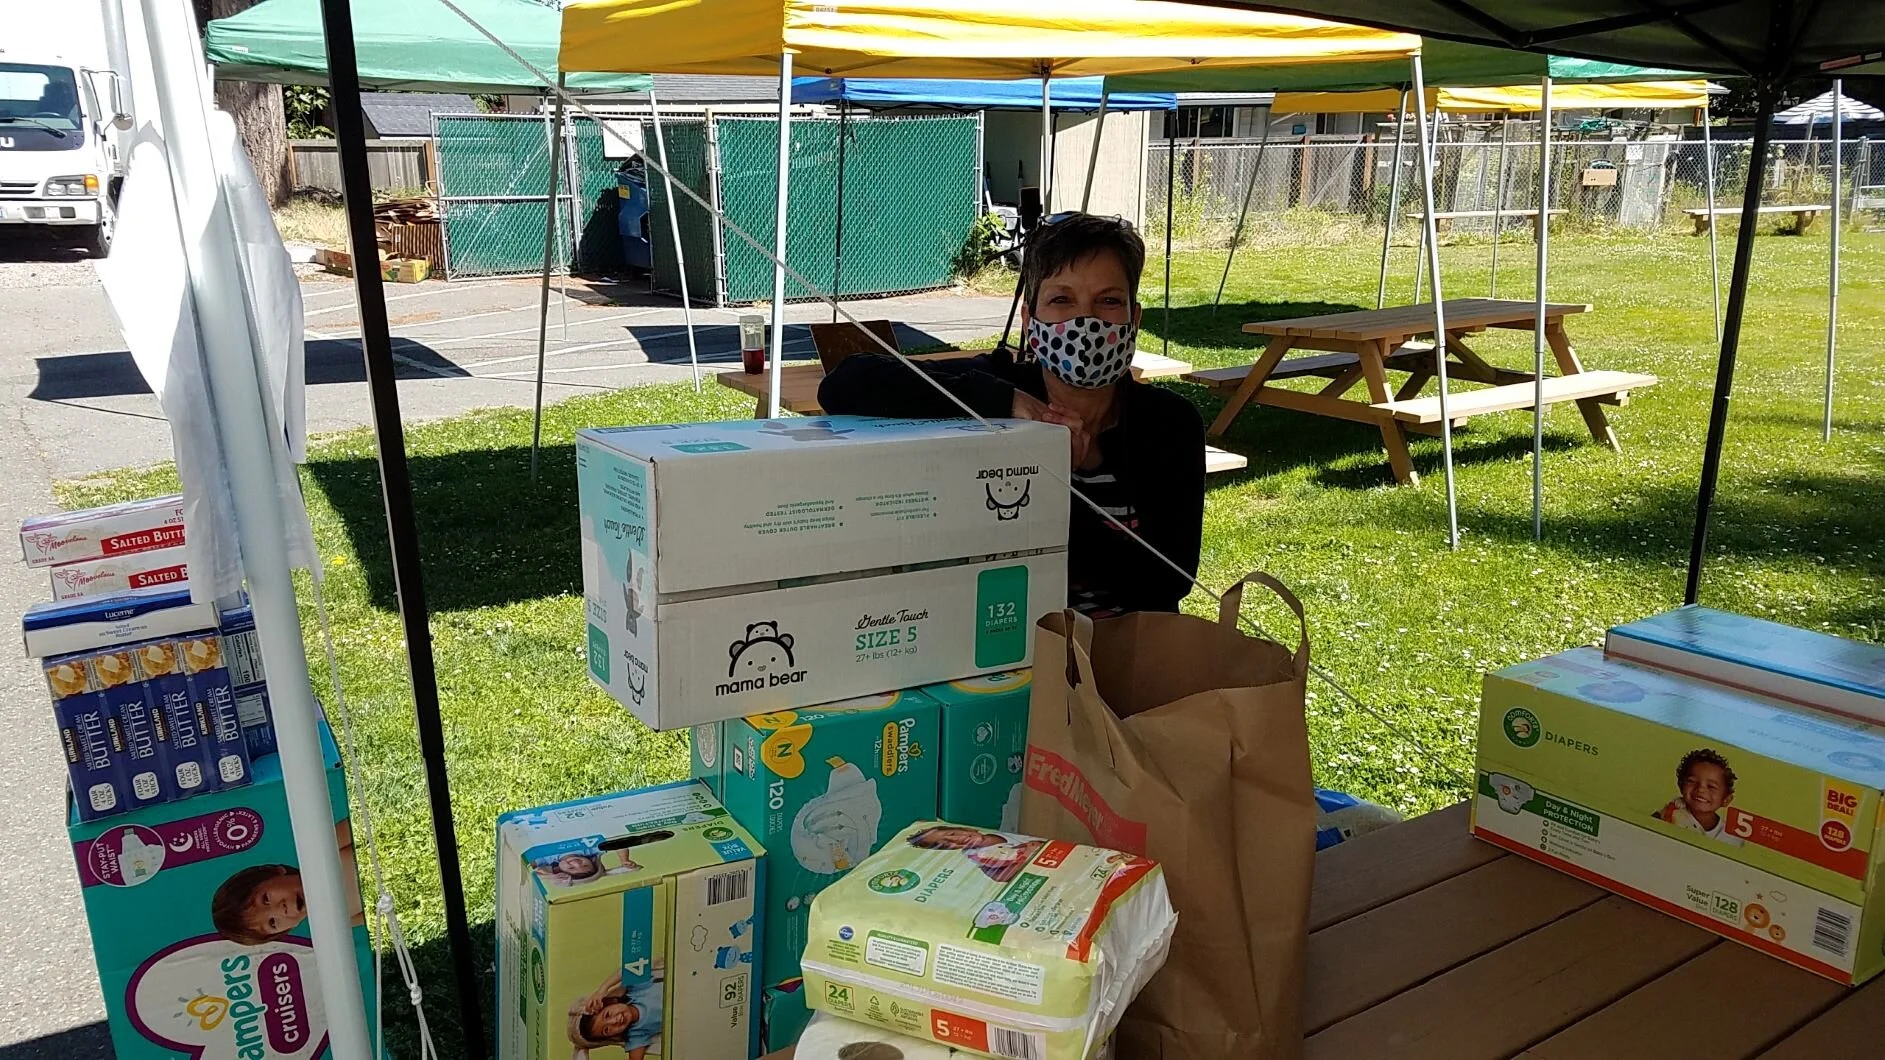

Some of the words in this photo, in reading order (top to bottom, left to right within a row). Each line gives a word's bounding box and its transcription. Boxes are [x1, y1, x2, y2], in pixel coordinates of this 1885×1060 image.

[976, 468, 1002, 480] bear
[1006, 465, 1039, 478] mama
[110, 536, 150, 550] SALTED
[140, 572, 178, 586] SALTED
[105, 609, 136, 620] Lucerne
[855, 614, 896, 630] Gentle
[896, 609, 928, 623] Touch
[988, 602, 1015, 618] 132
[985, 616, 1018, 627] DIAPERS
[856, 629, 900, 650] SIZE
[907, 626, 917, 642] 5
[856, 654, 870, 662] 27+
[872, 652, 883, 660] lbs
[886, 648, 903, 658] (12+
[904, 646, 918, 656] kg)
[715, 680, 764, 697] mama
[769, 669, 808, 688] bear
[171, 690, 197, 748] BUTTER
[195, 702, 209, 736] KIRKLAND
[215, 685, 239, 742] BUTTER
[108, 718, 122, 753] KIRKLAND
[128, 700, 155, 759] BUTTER
[152, 708, 166, 742] KIRKLAND
[63, 728, 77, 763] KIRKLAND
[84, 710, 111, 770] BUTTER
[777, 743, 793, 758] N
[898, 718, 915, 774] Pampers
[1545, 731, 1599, 756] DIAPERS
[191, 763, 200, 784] STICKS
[233, 756, 242, 778] STICKS
[148, 773, 158, 795] STICKS
[769, 779, 784, 809] 120
[104, 785, 114, 806] STICKS
[1827, 789, 1857, 808] BIG
[1546, 800, 1561, 812] Day
[1571, 809, 1593, 824] Night
[1827, 802, 1854, 816] DEAL!
[682, 821, 724, 831] DIAPERS
[1544, 809, 1593, 832] PROTECTION
[1734, 812, 1754, 838] 5
[1827, 826, 1845, 838] 128
[96, 843, 111, 879] STAY-PUT
[1038, 858, 1057, 866] 5
[1094, 869, 1108, 878] 24
[915, 868, 955, 903] DIAPERS
[1686, 885, 1710, 899] Super
[1687, 893, 1708, 906] Value
[1714, 896, 1738, 914] 128
[1712, 908, 1737, 922] DIAPERS
[624, 957, 649, 976] 4
[724, 982, 736, 1001] 92
[828, 985, 848, 1000] 24
[272, 963, 299, 1042] cruisers
[936, 1019, 949, 1036] 5
